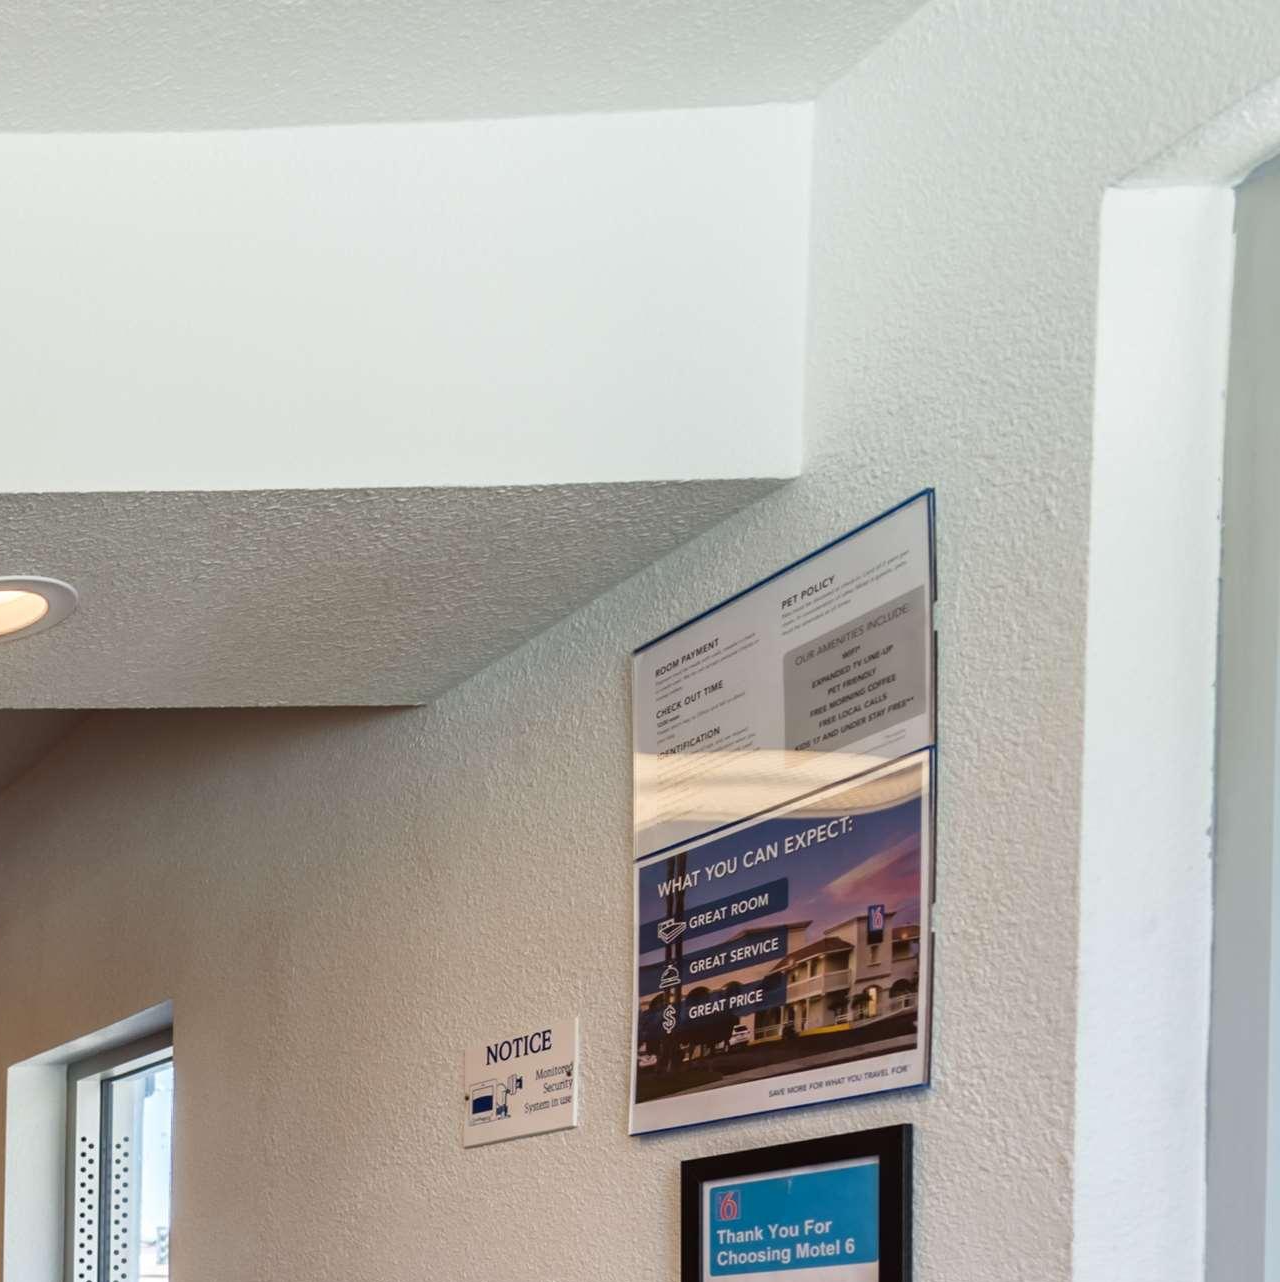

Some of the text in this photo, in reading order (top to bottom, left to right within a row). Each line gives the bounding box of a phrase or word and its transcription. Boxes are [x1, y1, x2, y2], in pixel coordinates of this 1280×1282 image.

[781, 575, 836, 609] PET POLICY
[655, 658, 680, 677] ROOM
[681, 638, 719, 664] PAYMENT
[811, 664, 851, 688] EXPANDED
[827, 667, 877, 695] PET FRIENDLY
[655, 701, 682, 719] CHECK
[684, 690, 702, 706] OUT
[704, 680, 724, 696] TIME
[809, 704, 827, 717] FREE
[867, 673, 896, 692] COFFEE
[818, 693, 888, 728] FREE LOCAL CALLS
[657, 816, 853, 898] WHAT YOU CAN EXPECT:
[689, 893, 769, 929] GREAT ROOM
[689, 937, 779, 974] GREAT SERVICE
[688, 989, 763, 1019] GREAT PRICE
[486, 1029, 552, 1066] NOTICE
[536, 1061, 573, 1080] Monitored
[769, 1087, 785, 1098] SAVE
[787, 1084, 807, 1094] MORE
[809, 1081, 824, 1090] FOR
[825, 1077, 845, 1087] WHAT
[847, 1074, 862, 1082] YOU
[864, 1069, 889, 1079] TRAVEL
[717, 1219, 832, 1244] Thank You For
[717, 1238, 855, 1266] Choosing Motel 6
